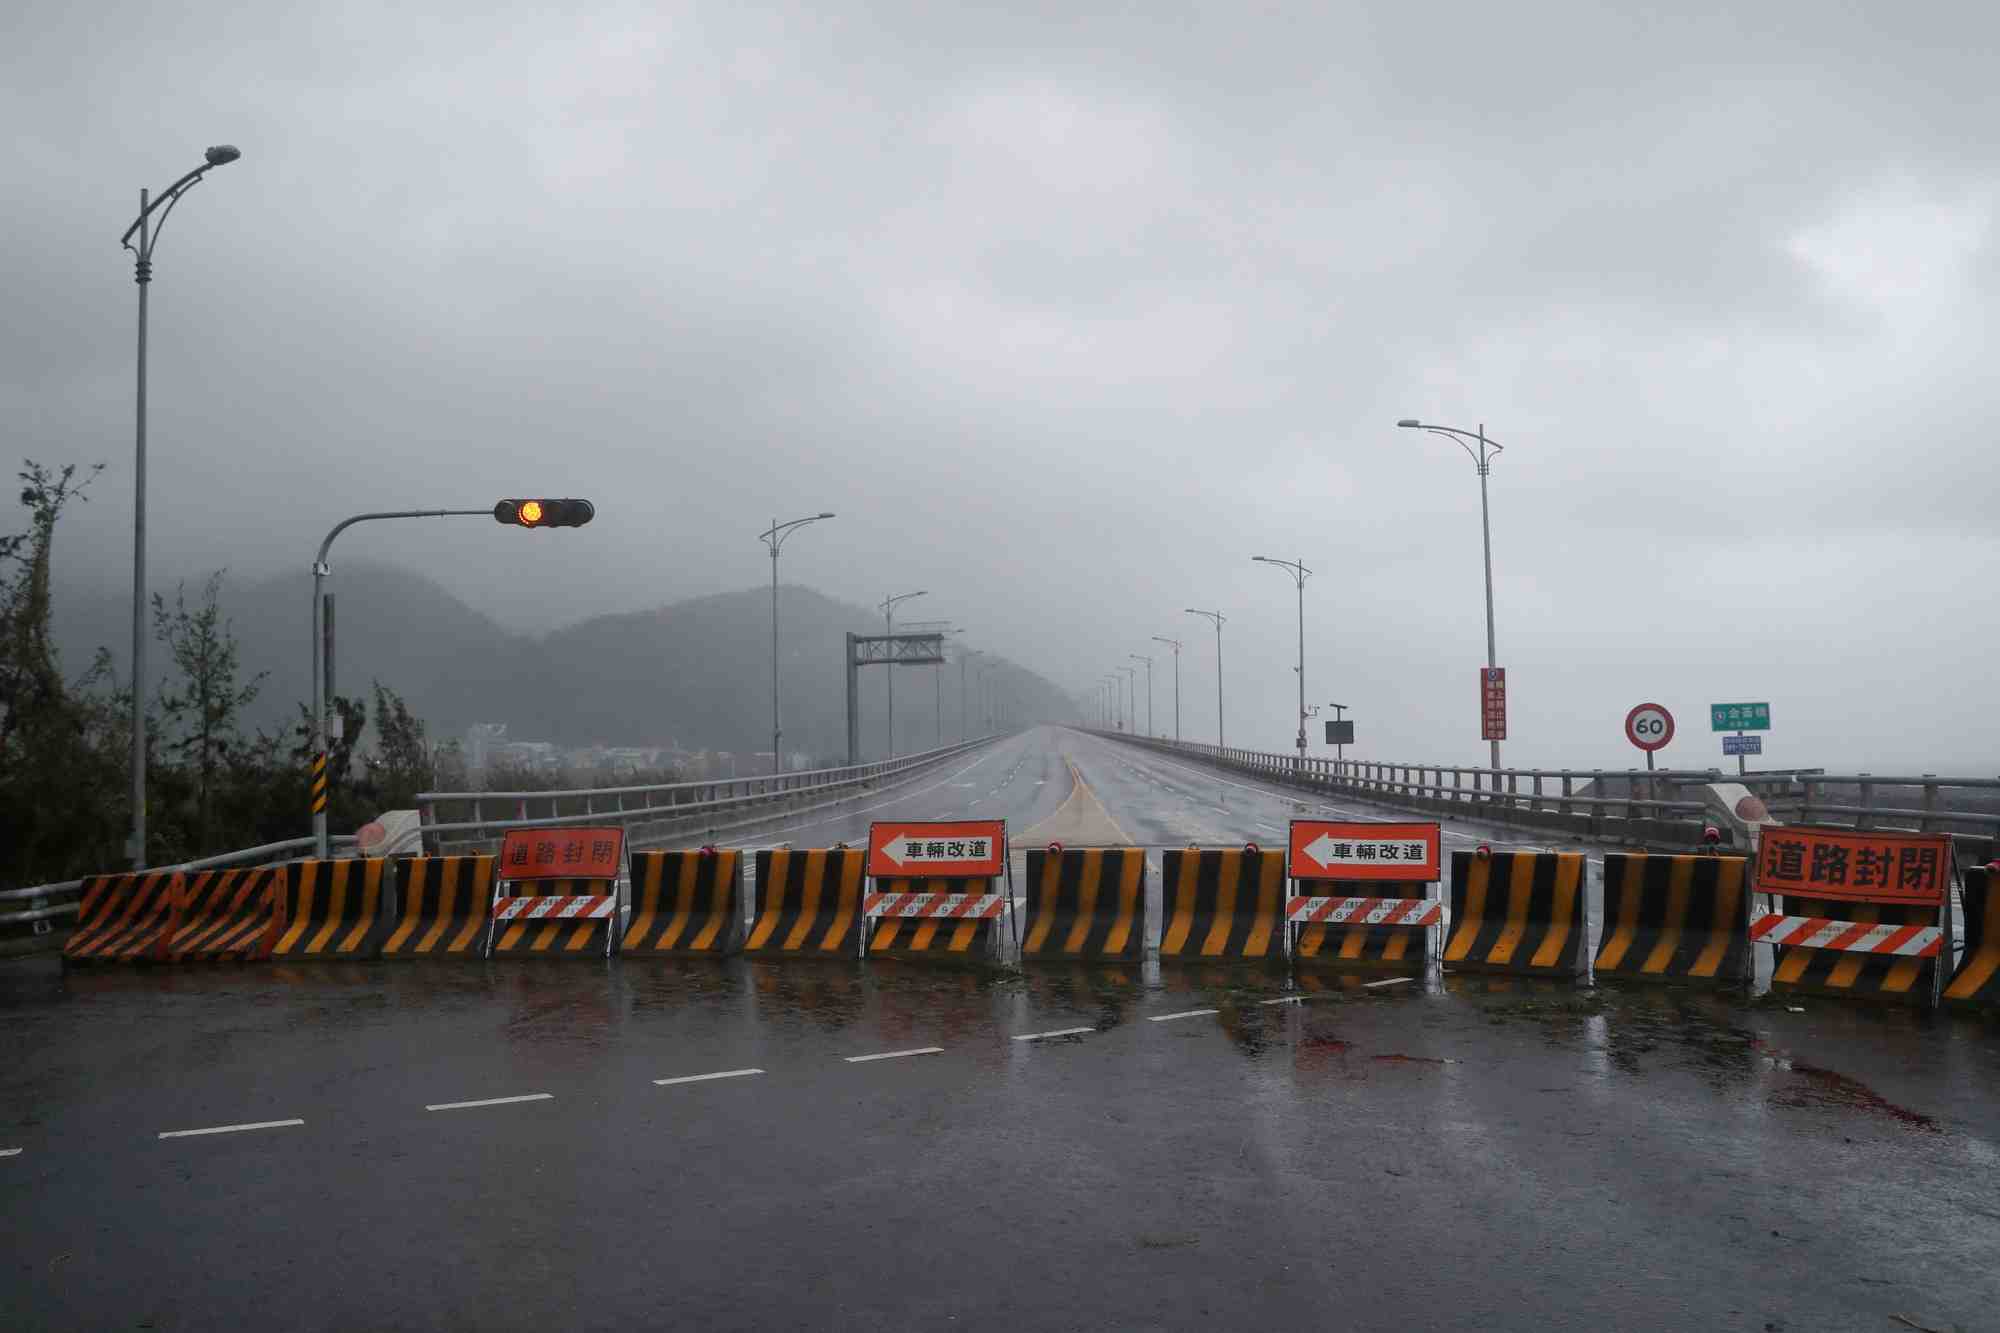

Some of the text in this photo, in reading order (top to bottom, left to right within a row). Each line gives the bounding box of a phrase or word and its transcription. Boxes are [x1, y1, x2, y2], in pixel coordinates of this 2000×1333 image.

[1635, 718, 1663, 735] 60
[511, 840, 614, 865] 道路封閉
[905, 840, 987, 858] 車輛改道
[1332, 842, 1424, 861] 車輛改道
[1766, 839, 1938, 891] 道路封閉
